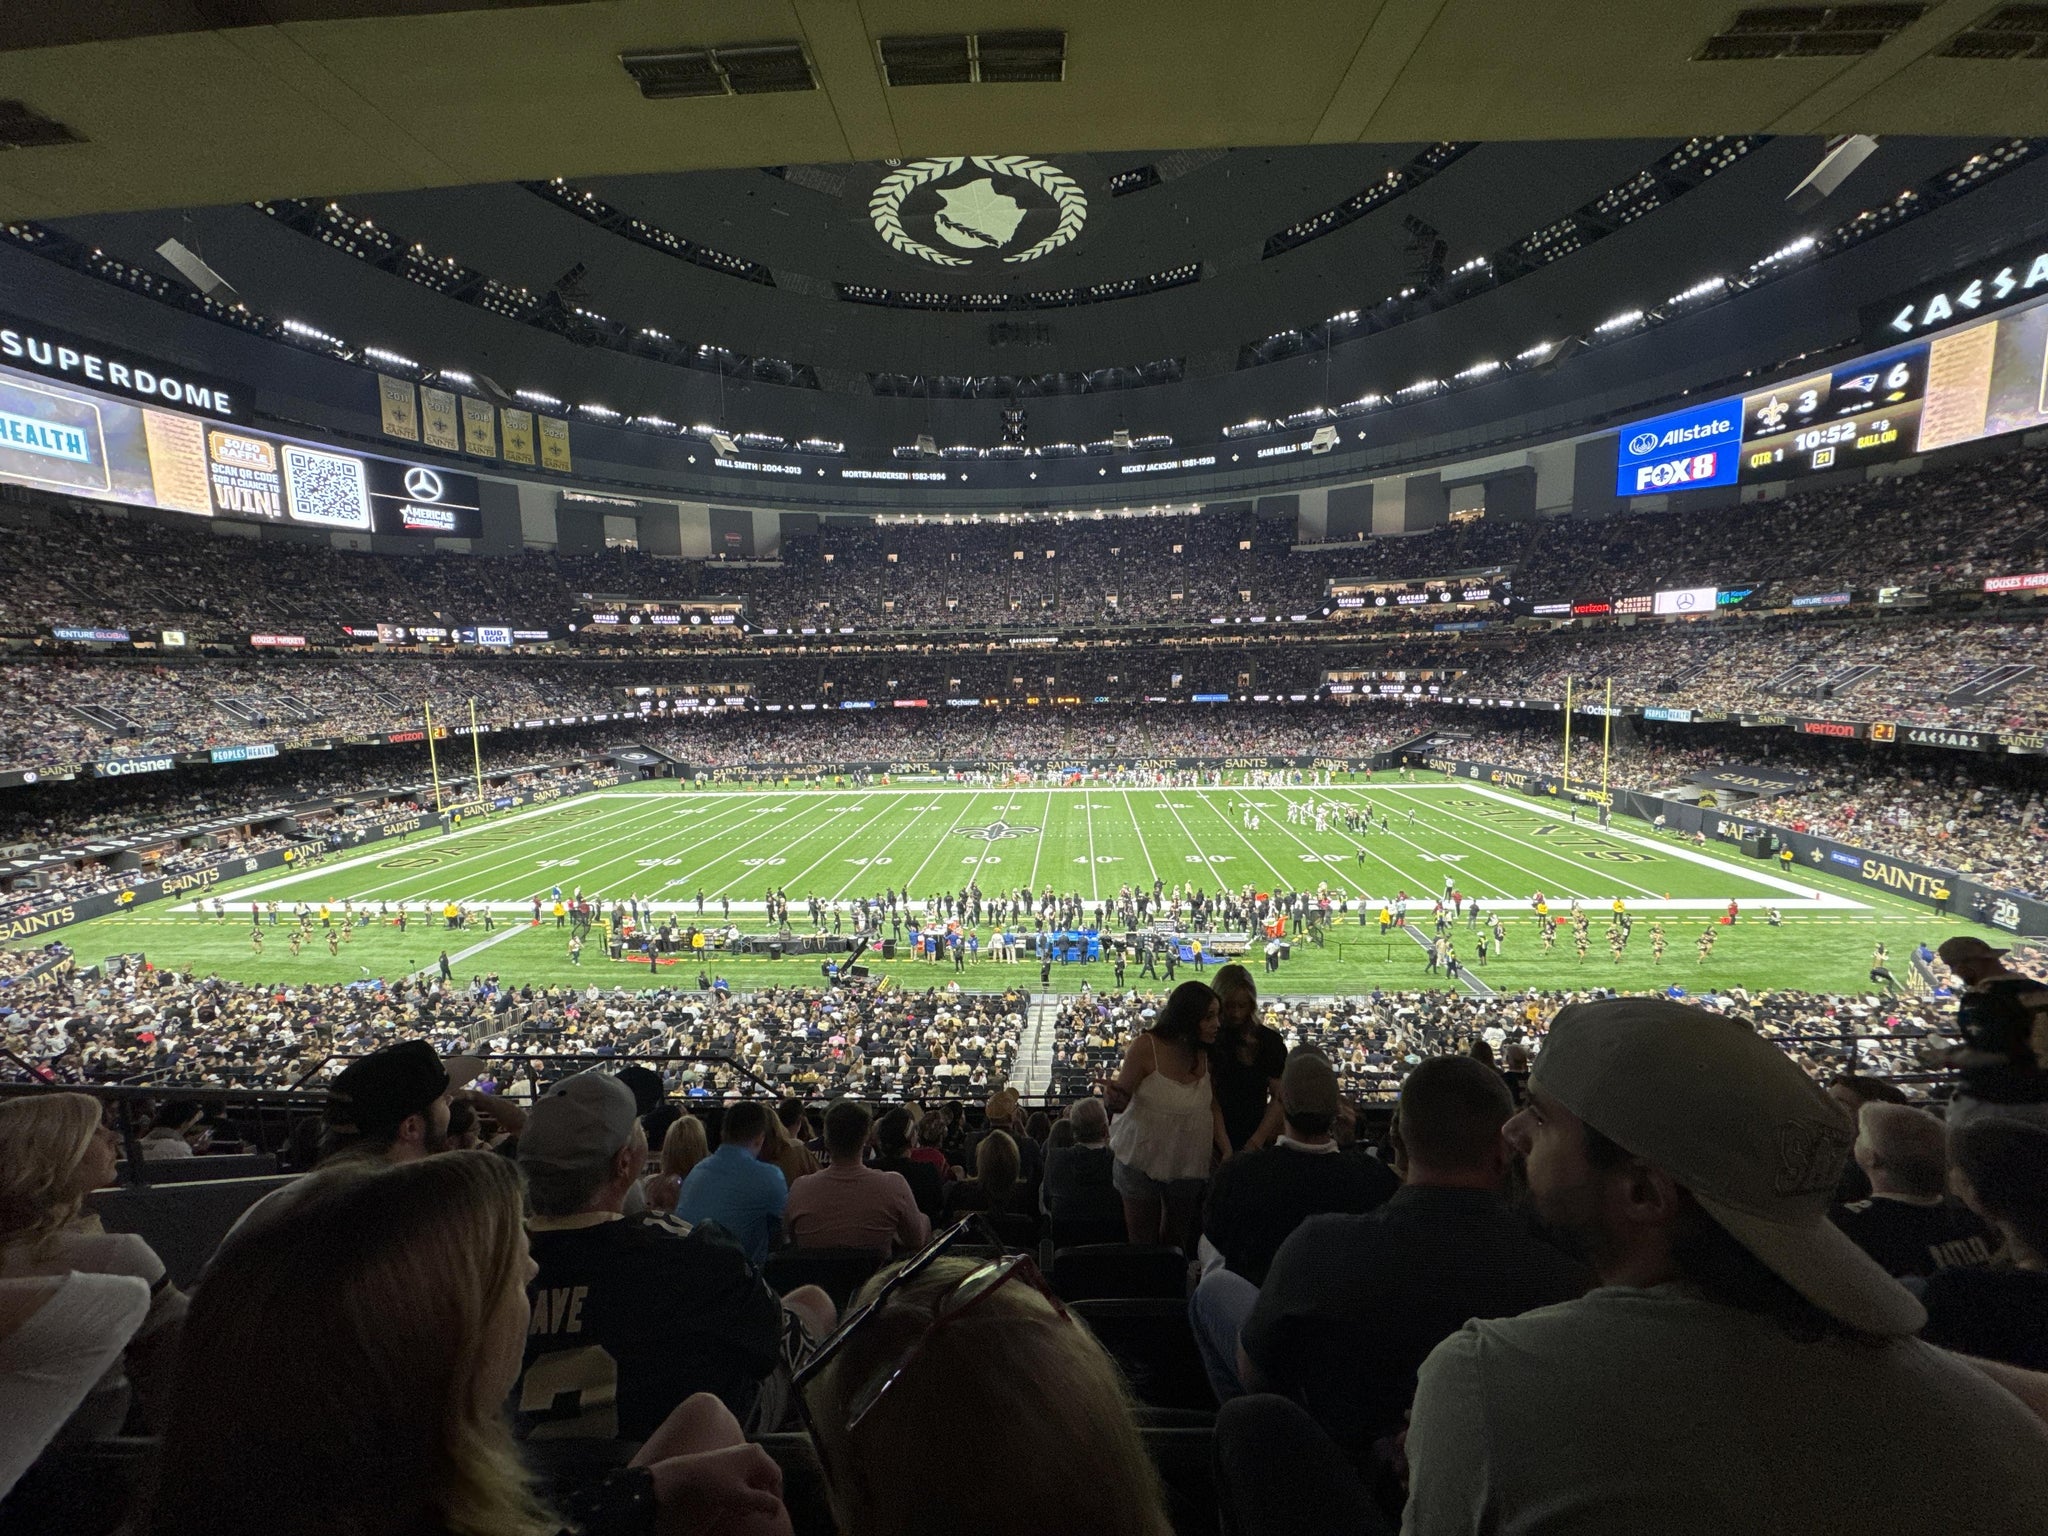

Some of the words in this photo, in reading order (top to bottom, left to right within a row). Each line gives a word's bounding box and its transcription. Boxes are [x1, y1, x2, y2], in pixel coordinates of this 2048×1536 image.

[0, 329, 232, 414] SUPERDOME
[1888, 362, 1909, 388] 6
[387, 391, 408, 403] 2011
[1798, 390, 1818, 413] 3
[428, 402, 450, 414] 2017
[386, 426, 417, 440] SAINTS
[1659, 418, 1731, 448] Allstate
[1795, 422, 1857, 450] 10:52
[1857, 434, 1880, 449] BALL
[1881, 429, 1897, 443] ON
[224, 438, 260, 453] 50/50
[426, 436, 457, 449] SAINTS
[219, 446, 268, 463] RAFFLE
[467, 445, 495, 456] SAINTS
[1258, 447, 1274, 458] SAM
[1275, 444, 1297, 455] MILLS
[505, 454, 533, 465] SAINTS
[1751, 451, 1772, 469] QTR
[1774, 448, 1784, 462] 1
[1816, 451, 1830, 463] 21
[543, 461, 570, 471] SAINTS
[715, 459, 733, 469] WILL
[734, 460, 758, 471] SMITH
[762, 464, 801, 475] 2004-2013
[1121, 464, 1146, 474] RICKEY
[1147, 460, 1178, 472] JACKSON
[1182, 456, 1215, 467] 1981-1993
[211, 463, 238, 477] SCAN
[239, 468, 252, 479] QR
[254, 471, 279, 484] CODE
[842, 470, 871, 478] MORTEN
[872, 471, 908, 480] ANDERSEN
[912, 472, 946, 481] 1982-1994
[213, 474, 229, 484] FOR
[231, 477, 237, 486] A
[237, 479, 268, 491] CHANCE
[269, 484, 280, 492] TO
[214, 483, 282, 516] WIN!
[400, 505, 454, 523] AMERICAS
[1986, 578, 2021, 589] ROUSES
[1792, 597, 1821, 606] VENTURE
[1823, 594, 1850, 603] GLOBAL
[1574, 603, 1609, 613] verizon
[53, 630, 95, 639] VENTURE
[96, 631, 129, 639] GLOBAL
[352, 629, 378, 637] TOYOTA
[395, 627, 405, 638] 3
[416, 627, 437, 636] 10:52
[451, 629, 459, 639] 6
[251, 636, 276, 644] ROUSES
[277, 636, 305, 645] MARKETS
[1645, 709, 1668, 719] PEOPLES
[1703, 711, 1727, 720] SAINTS
[1758, 715, 1786, 724] SAINTS
[1804, 721, 1854, 737] verizon
[1874, 725, 1893, 738] 21
[343, 734, 367, 743] SAINTS
[388, 731, 423, 743] verizon
[1908, 729, 1979, 747] CAESARS
[1998, 735, 2044, 749] SAINTS
[285, 740, 312, 749] SAINTS
[212, 749, 246, 762] PEOPLES
[247, 745, 275, 758] HEALTH
[106, 758, 173, 776] Ochsner
[1135, 759, 1176, 769] SAINTS
[1225, 757, 1268, 769] SAINTS
[1429, 758, 1456, 773] SAINTS
[39, 764, 82, 776] SAINTS
[533, 788, 560, 801] SAINTS
[464, 802, 495, 816] SAINTS
[152, 806, 295, 838] SUPERDOME
[383, 818, 420, 837] SAINTS
[640, 858, 682, 867] 20
[747, 857, 786, 866] 30
[854, 857, 893, 865] 40
[962, 856, 1002, 864] 50
[1073, 856, 1113, 864] 40
[1185, 855, 1226, 863] 30
[1299, 854, 1343, 863] 20
[1417, 853, 1461, 862] 10
[162, 867, 220, 895] SAINTS
[1862, 859, 1947, 899] SAINTS
[1993, 904, 2020, 924] 20
[0, 905, 75, 940] SAINTS
